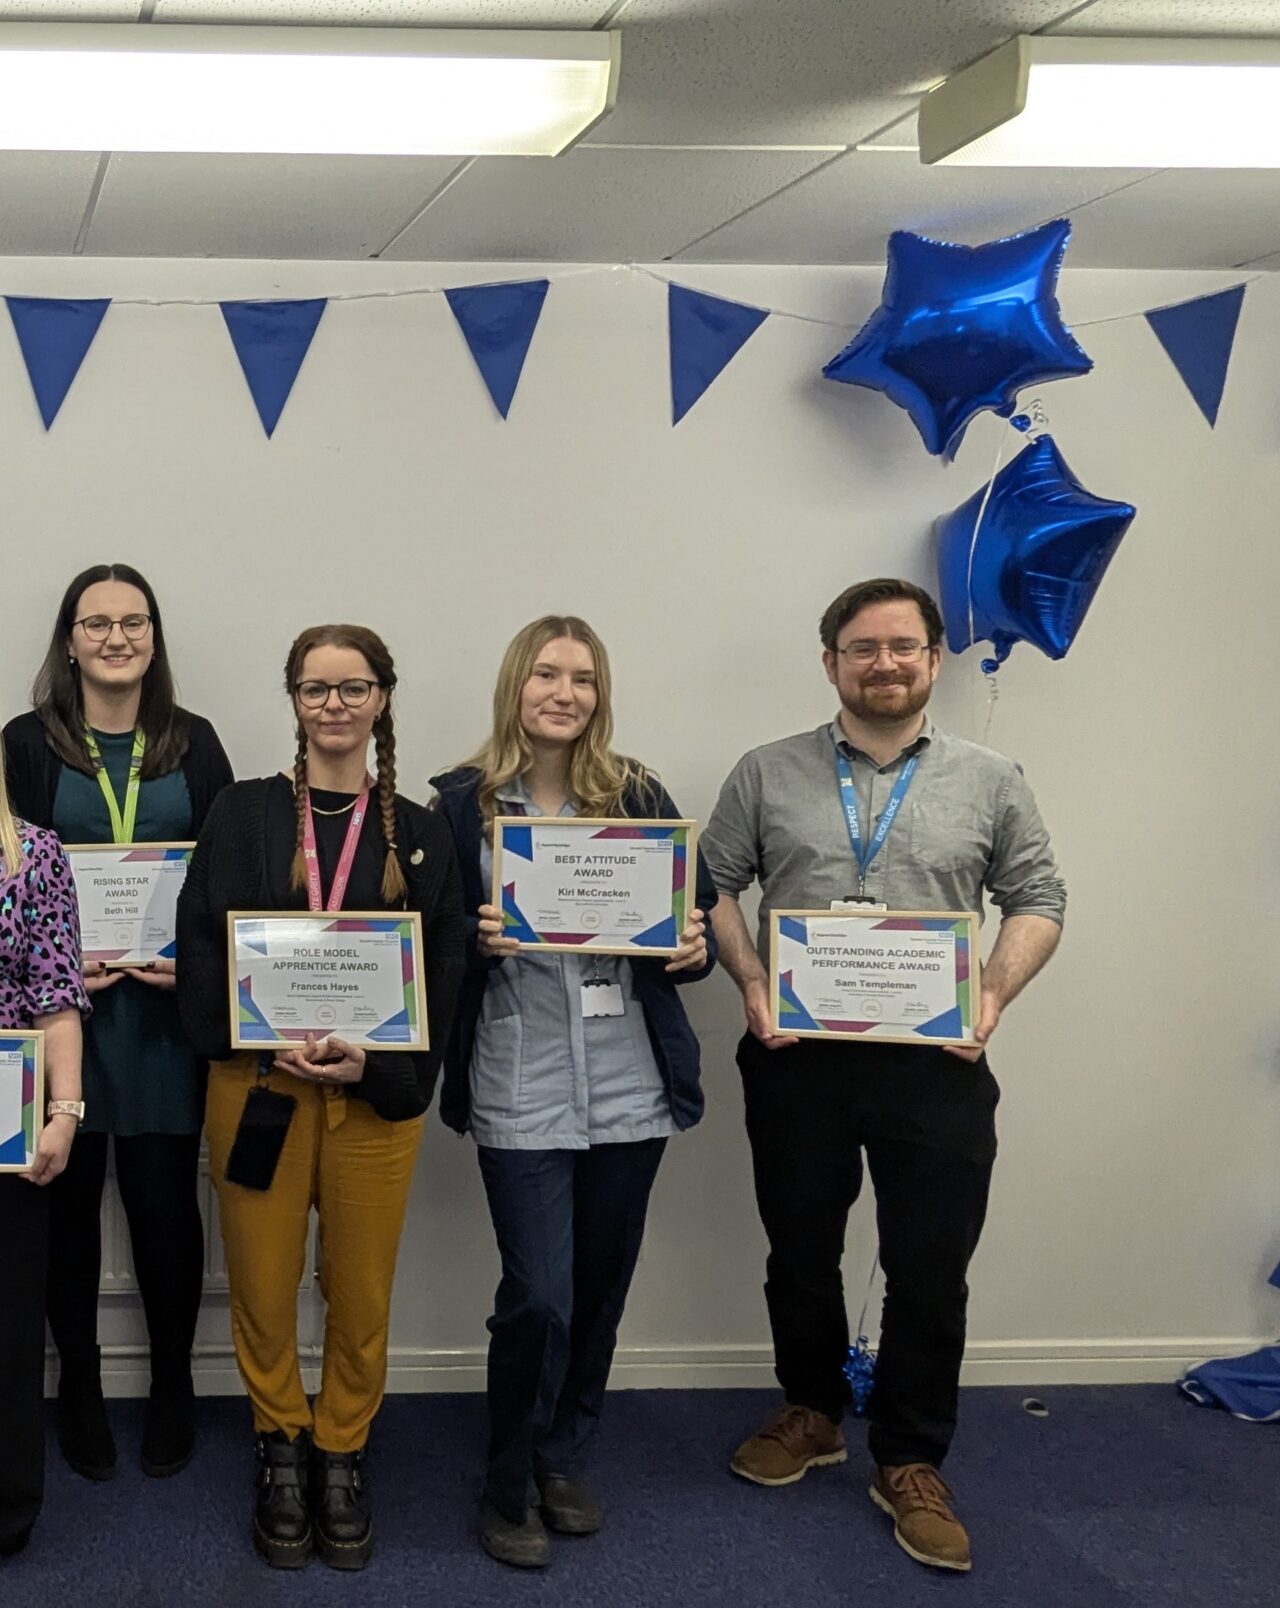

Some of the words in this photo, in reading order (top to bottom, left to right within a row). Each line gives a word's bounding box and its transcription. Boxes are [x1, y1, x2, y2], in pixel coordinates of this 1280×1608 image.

[846, 805, 860, 839] RESPECT
[875, 798, 900, 841] EXCELLENCE
[554, 855, 582, 864] BEST
[584, 855, 637, 865] ATTITUDE
[573, 868, 614, 878] AWARD
[93, 877, 124, 887] RISING
[125, 876, 150, 885] STAR
[104, 889, 139, 898] AWARD
[309, 872, 321, 912] NTEGRITY
[557, 887, 575, 897] Kiri
[576, 888, 631, 898] McCracken
[104, 906, 124, 915] Beth
[124, 906, 139, 915] Hill
[293, 948, 321, 958] ROLE
[323, 948, 360, 958] MODEL
[806, 946, 884, 957] OUTSTANDING
[887, 949, 946, 959] ACADEMIC
[272, 961, 338, 971] APPRENTICE
[339, 962, 379, 972] AWARD
[811, 960, 895, 971] PERFORMANCE
[898, 962, 941, 972] AWARD
[291, 982, 328, 991] Frances
[330, 982, 360, 993] Hayes
[834, 978, 857, 988] Sam
[859, 980, 917, 990] Templeman
